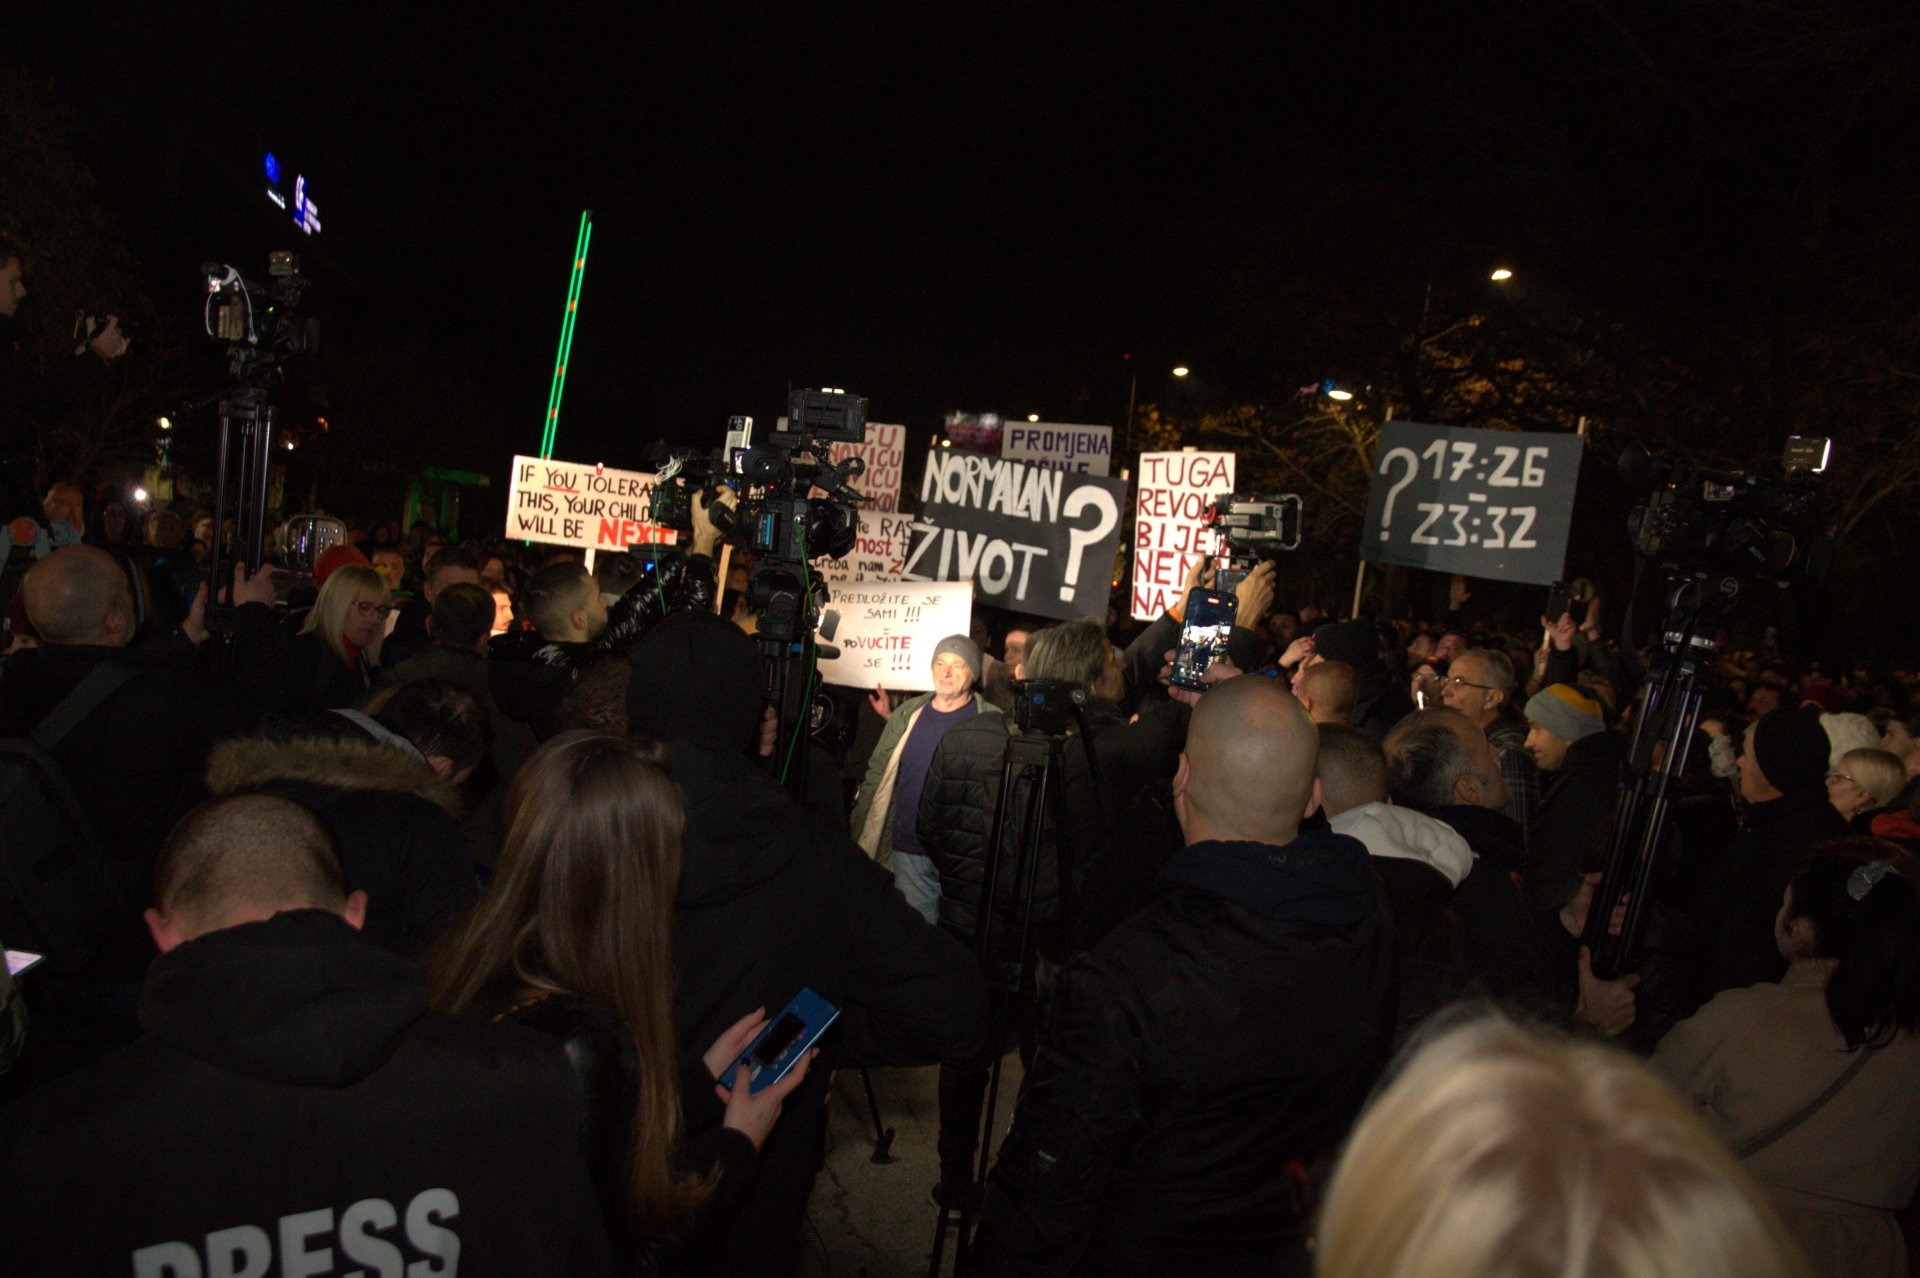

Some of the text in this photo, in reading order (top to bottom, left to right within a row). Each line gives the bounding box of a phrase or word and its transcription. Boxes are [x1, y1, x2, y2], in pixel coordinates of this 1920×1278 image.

[1010, 429, 1110, 459] PROMJENA
[1143, 456, 1231, 488] TUGA
[1421, 438, 1549, 488] 17:26
[519, 463, 654, 498] IF YOU TOLERA
[921, 449, 1063, 523] NORMALAN
[1378, 446, 1419, 541] ?
[517, 490, 560, 516] THIS,
[564, 495, 604, 517] YOUR
[517, 514, 675, 547] WILL BE NEXT
[1410, 502, 1537, 549] 23:32
[901, 516, 1048, 600] ŽIVOT
[1059, 485, 1118, 602] ?
[831, 589, 942, 605] PREDLOŽITE SE
[864, 608, 897, 619] SAMI
[864, 658, 882, 668] SE
